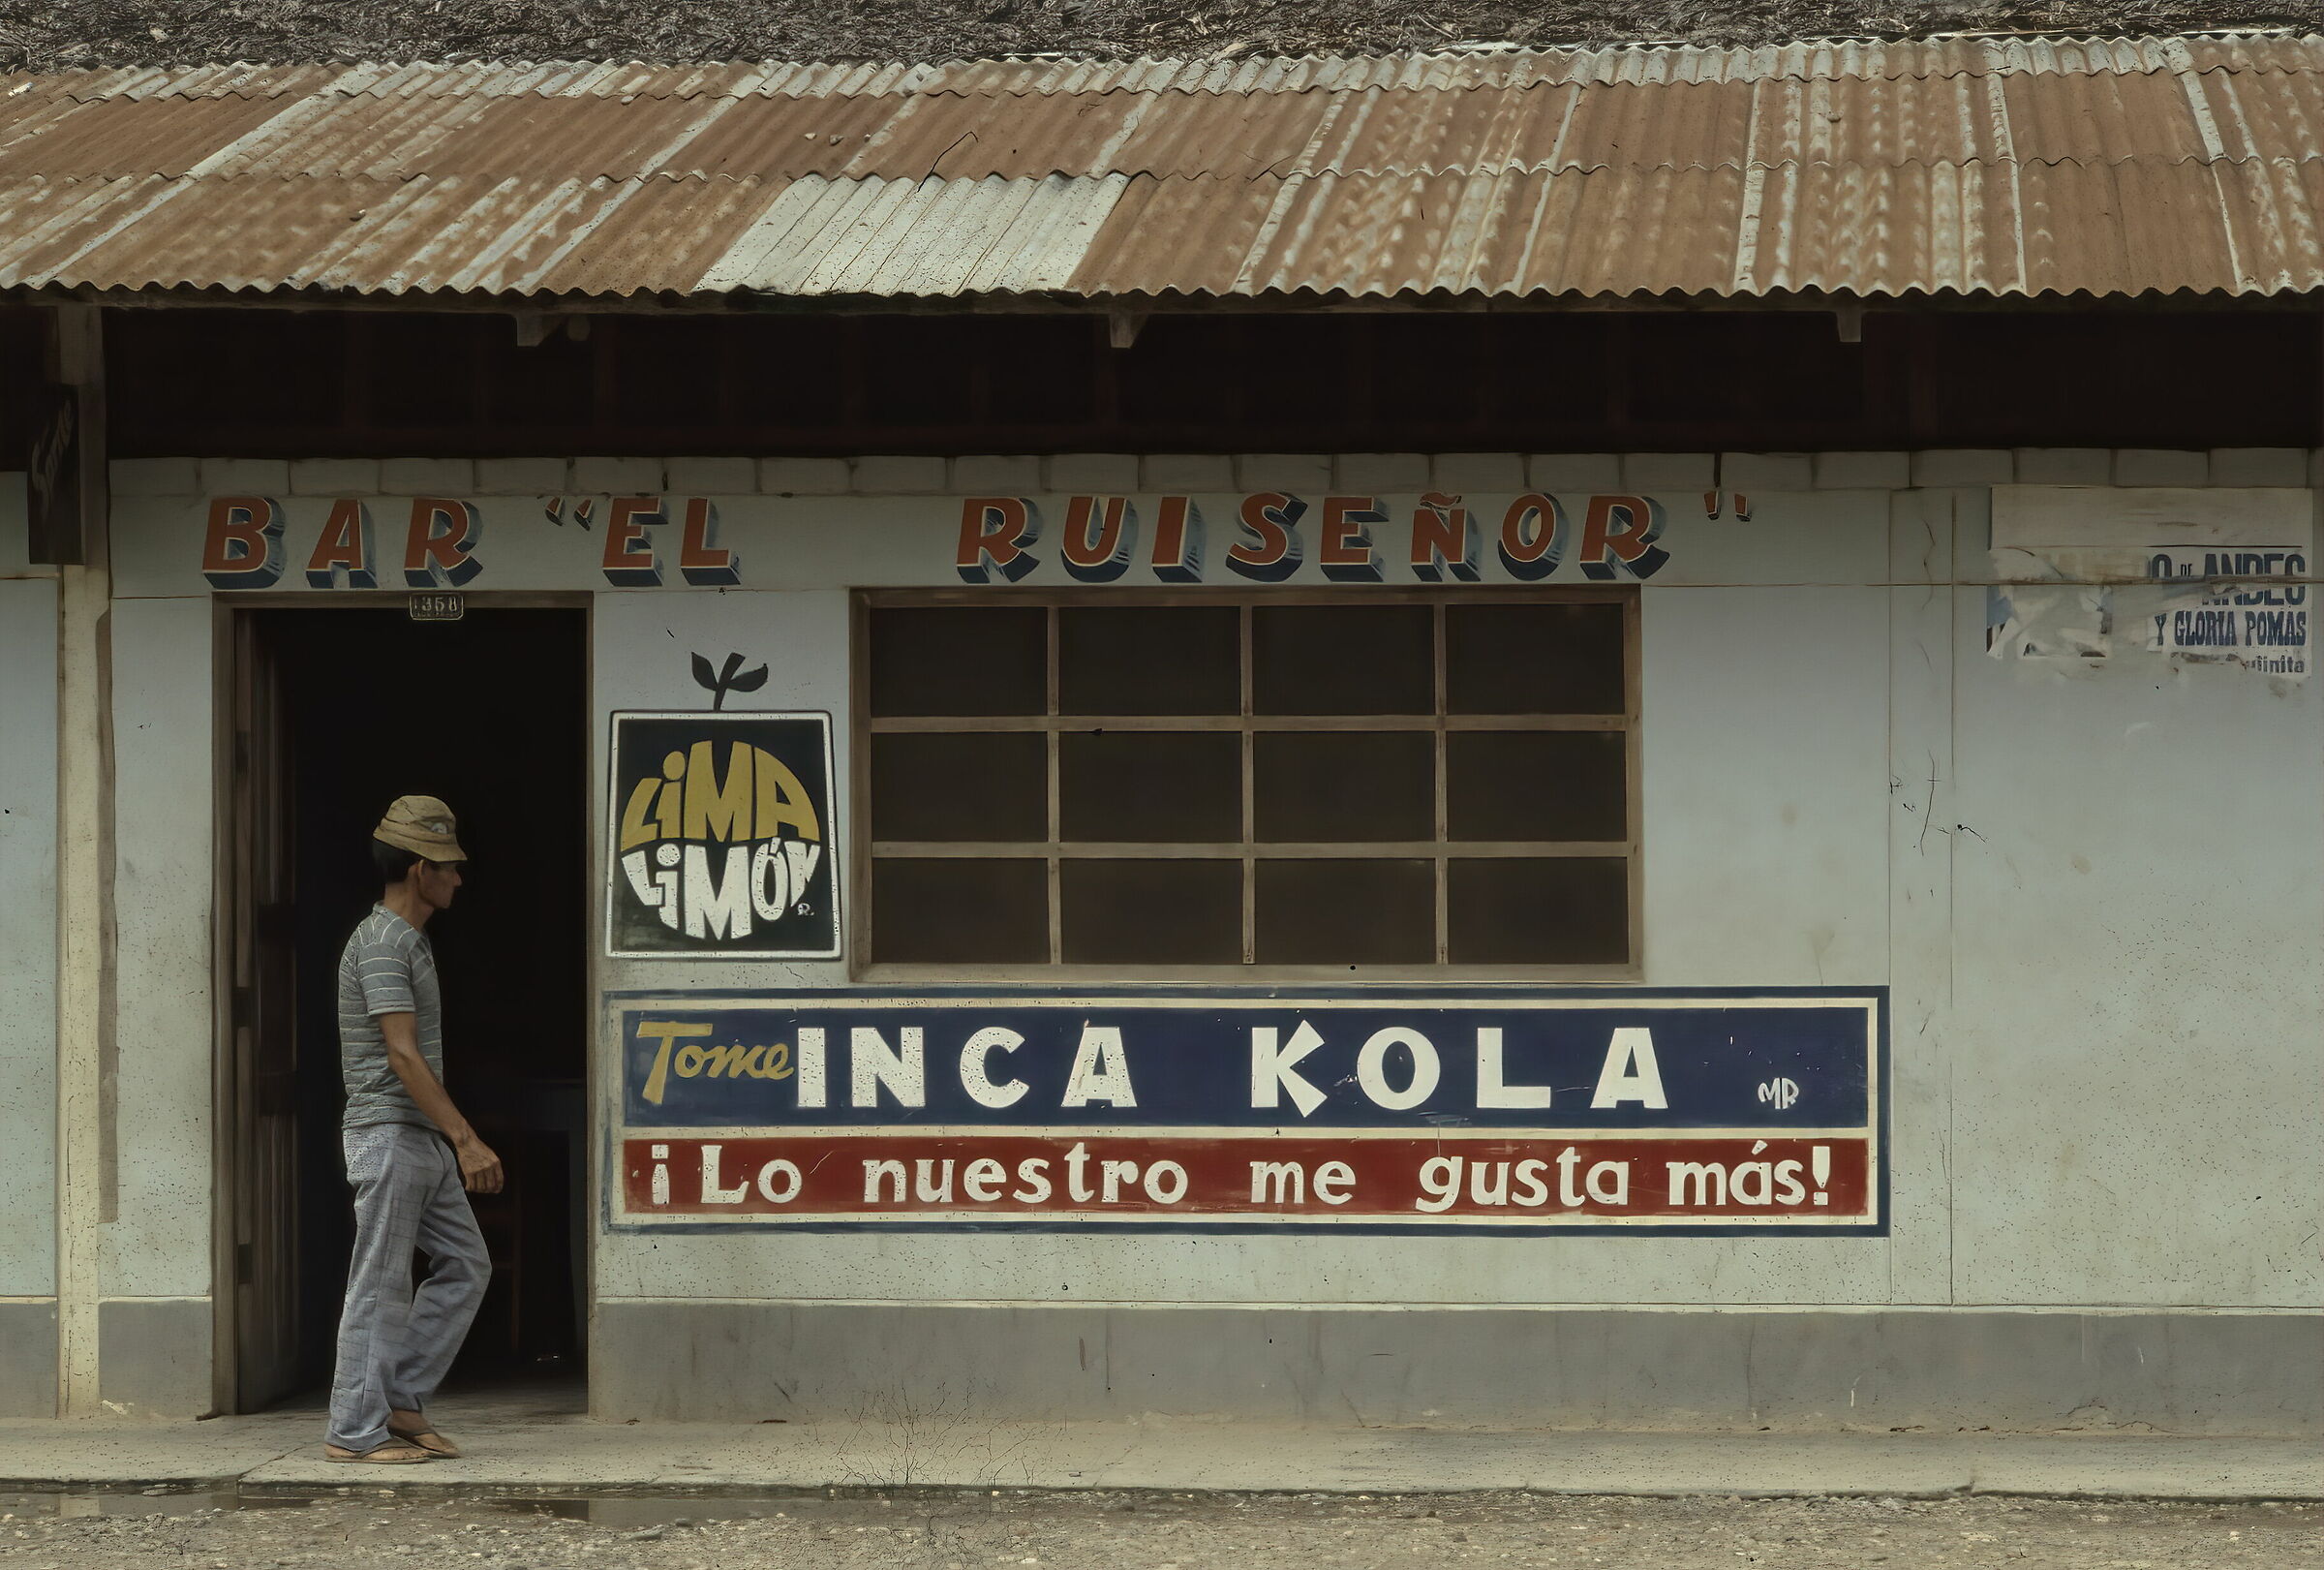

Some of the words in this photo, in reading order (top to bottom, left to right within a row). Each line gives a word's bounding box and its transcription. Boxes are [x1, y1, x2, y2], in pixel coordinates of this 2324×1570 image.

[201, 497, 483, 591] BAR
[2155, 612, 2167, 646] Y
[2174, 610, 2237, 646] GLORIA
[2245, 610, 2307, 646] POMAS
[637, 1020, 794, 1105] Tome
[797, 1023, 1138, 1108] INCA
[1250, 1019, 1669, 1118] KOLA
[1758, 1077, 1800, 1110] MR
[863, 1141, 1189, 1206] nuestro
[1249, 1160, 1358, 1205] me
[1414, 1146, 1631, 1213] gusta
[1666, 1139, 1833, 1207] más!
